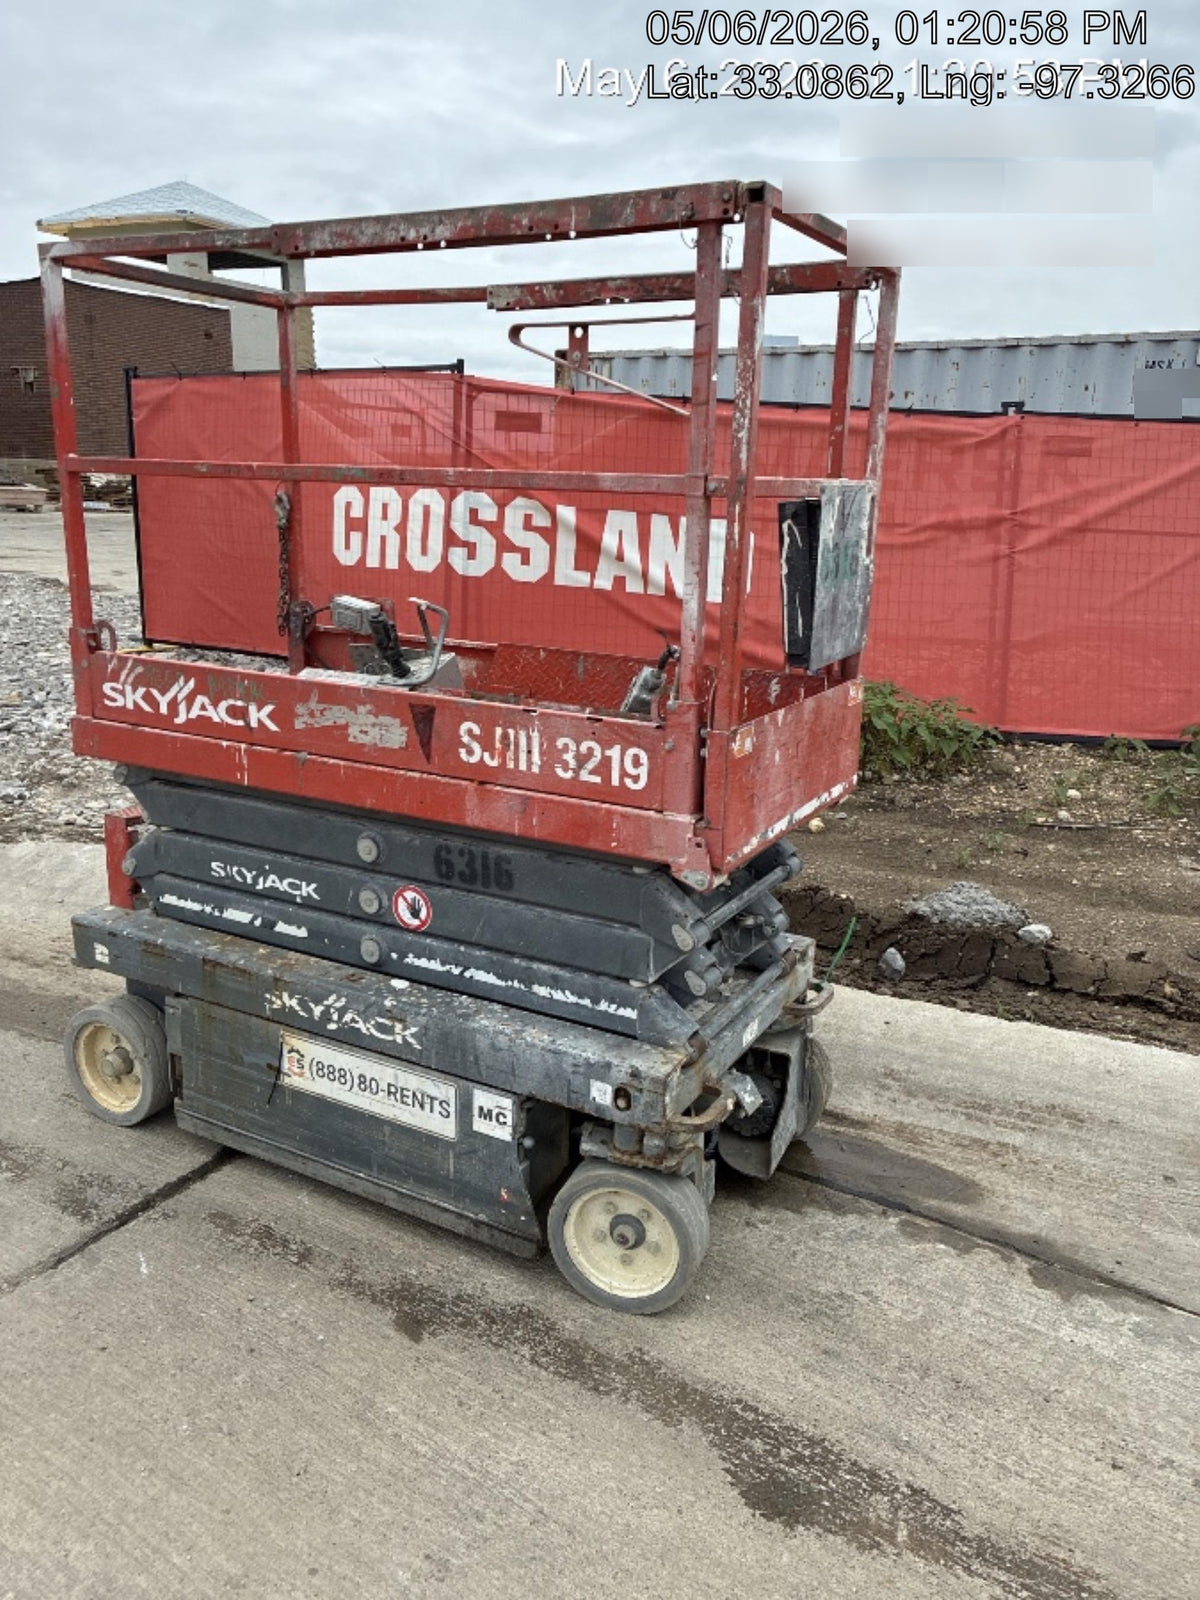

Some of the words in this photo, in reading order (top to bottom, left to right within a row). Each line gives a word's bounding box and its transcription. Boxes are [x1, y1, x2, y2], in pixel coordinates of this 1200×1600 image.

[102, 674, 281, 733] SKYJACK
[553, 736, 649, 791] 3219
[209, 860, 321, 901] SKYJACK
[433, 843, 515, 891] 6316
[263, 992, 423, 1050] SKYJACK
[477, 1104, 508, 1127] MC
